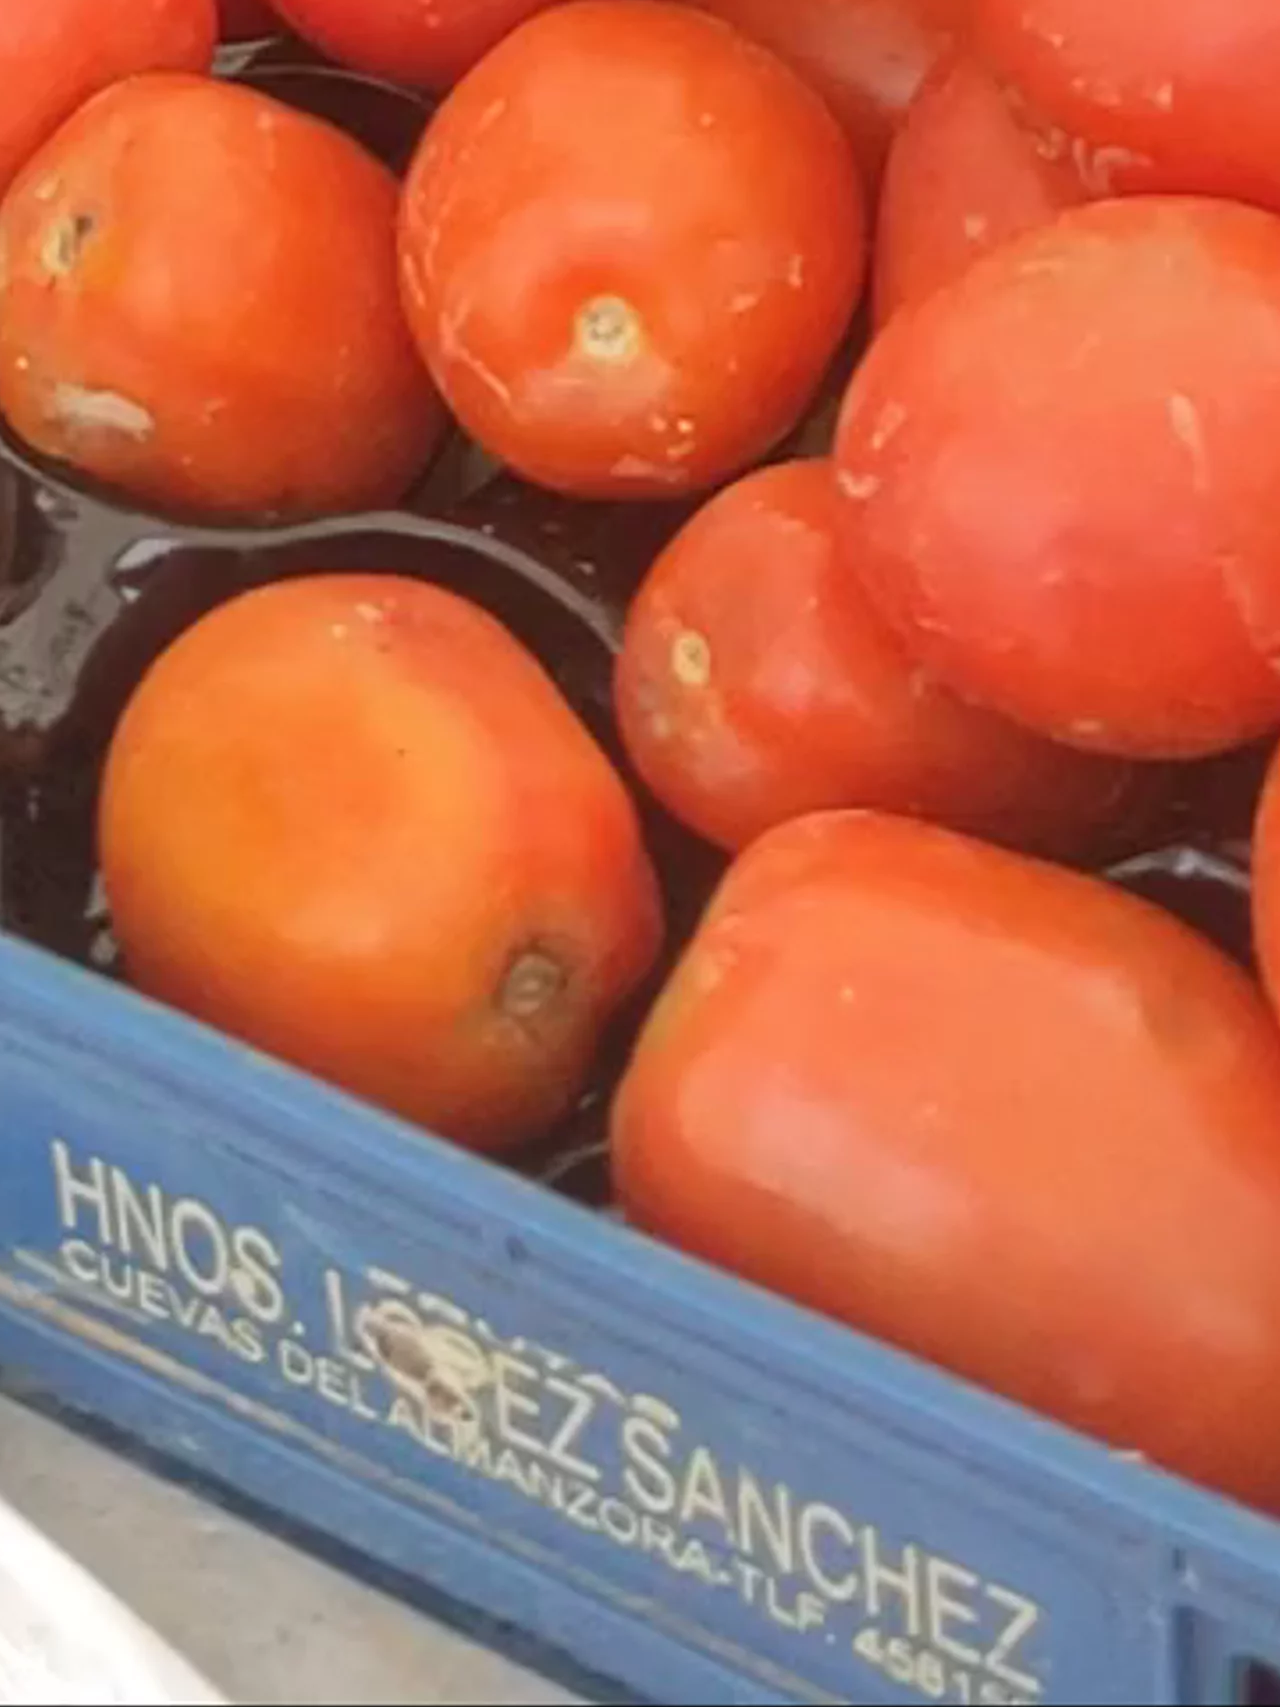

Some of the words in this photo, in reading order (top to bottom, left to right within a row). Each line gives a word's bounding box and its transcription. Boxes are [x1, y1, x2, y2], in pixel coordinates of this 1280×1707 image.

[53, 1138, 306, 1336] HNOS.
[622, 1414, 1040, 1694] SANCHEZ
[60, 1238, 267, 1364] CUEVAS
[277, 1338, 378, 1422] DEL
